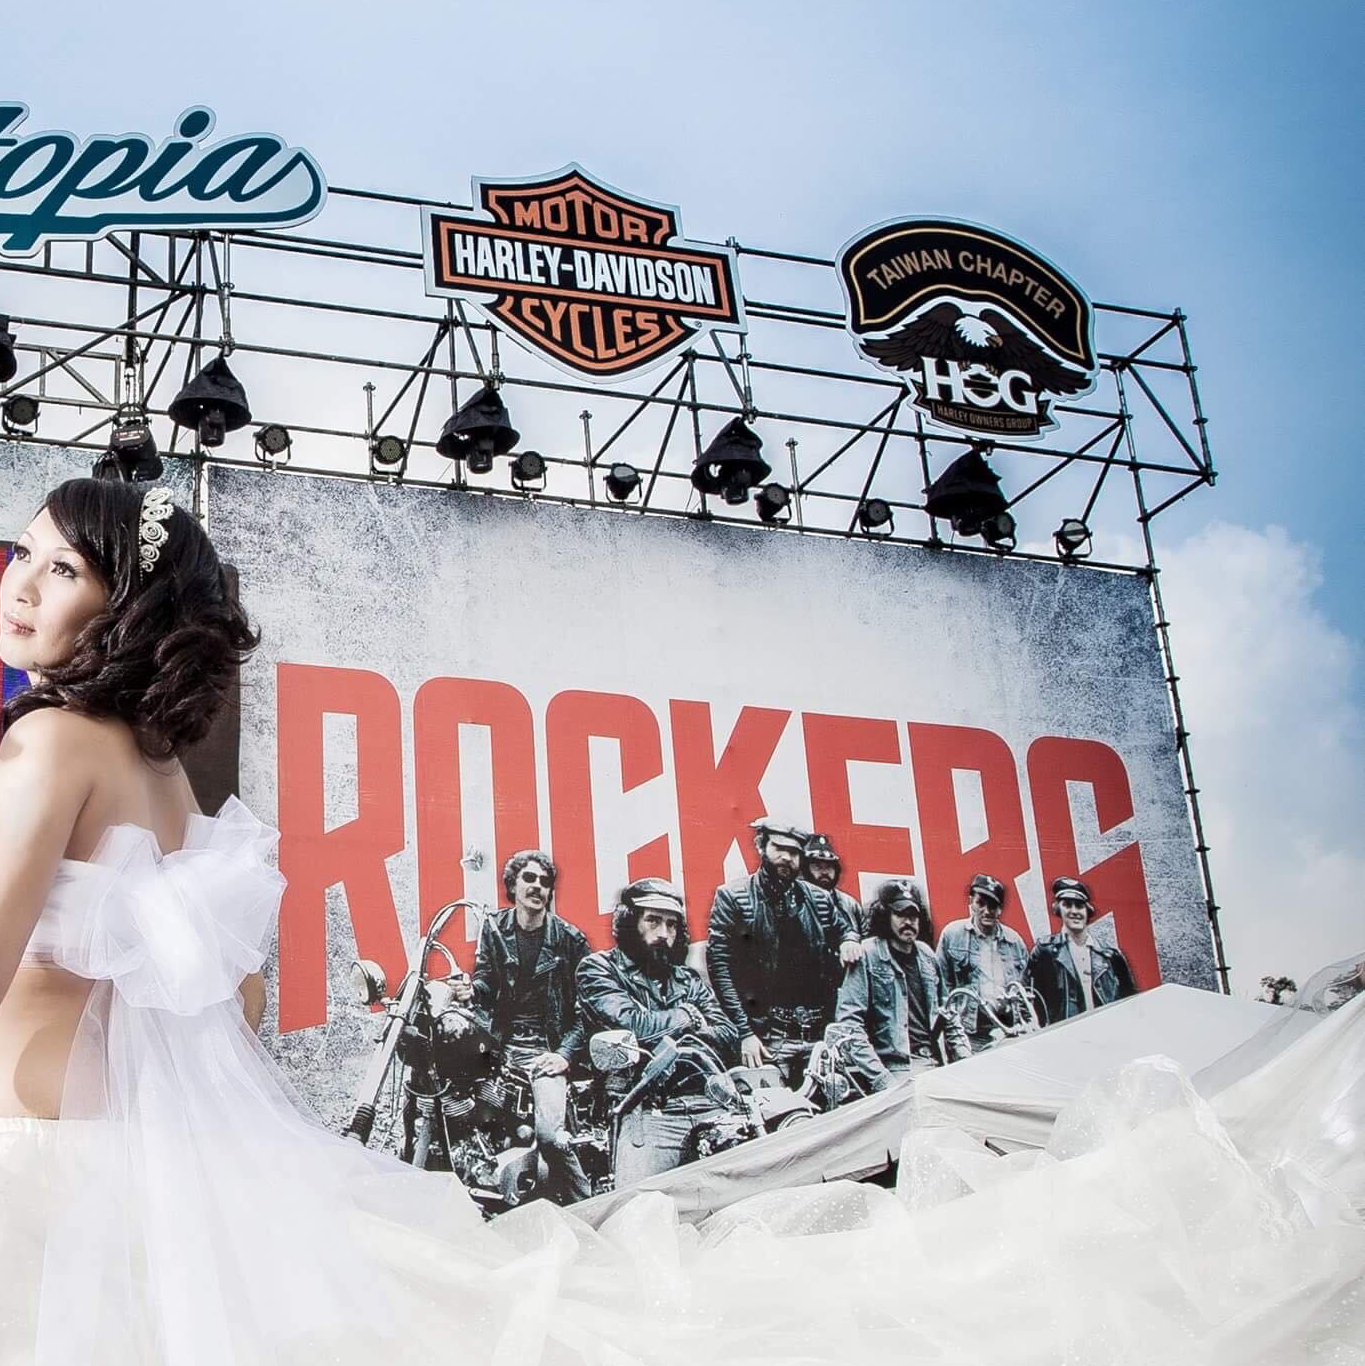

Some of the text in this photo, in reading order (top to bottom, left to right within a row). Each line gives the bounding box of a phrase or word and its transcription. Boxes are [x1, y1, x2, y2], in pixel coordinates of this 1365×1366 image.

[514, 190, 649, 244] MOTOR
[452, 232, 716, 306] HARLEY-DAVIDSON
[866, 248, 1067, 320] TAIWAN CHAPTER
[521, 297, 662, 361] CYCLES
[936, 404, 1033, 429] HARLEY OWNERS GROUP
[276, 661, 1163, 1034] ROCKERS
